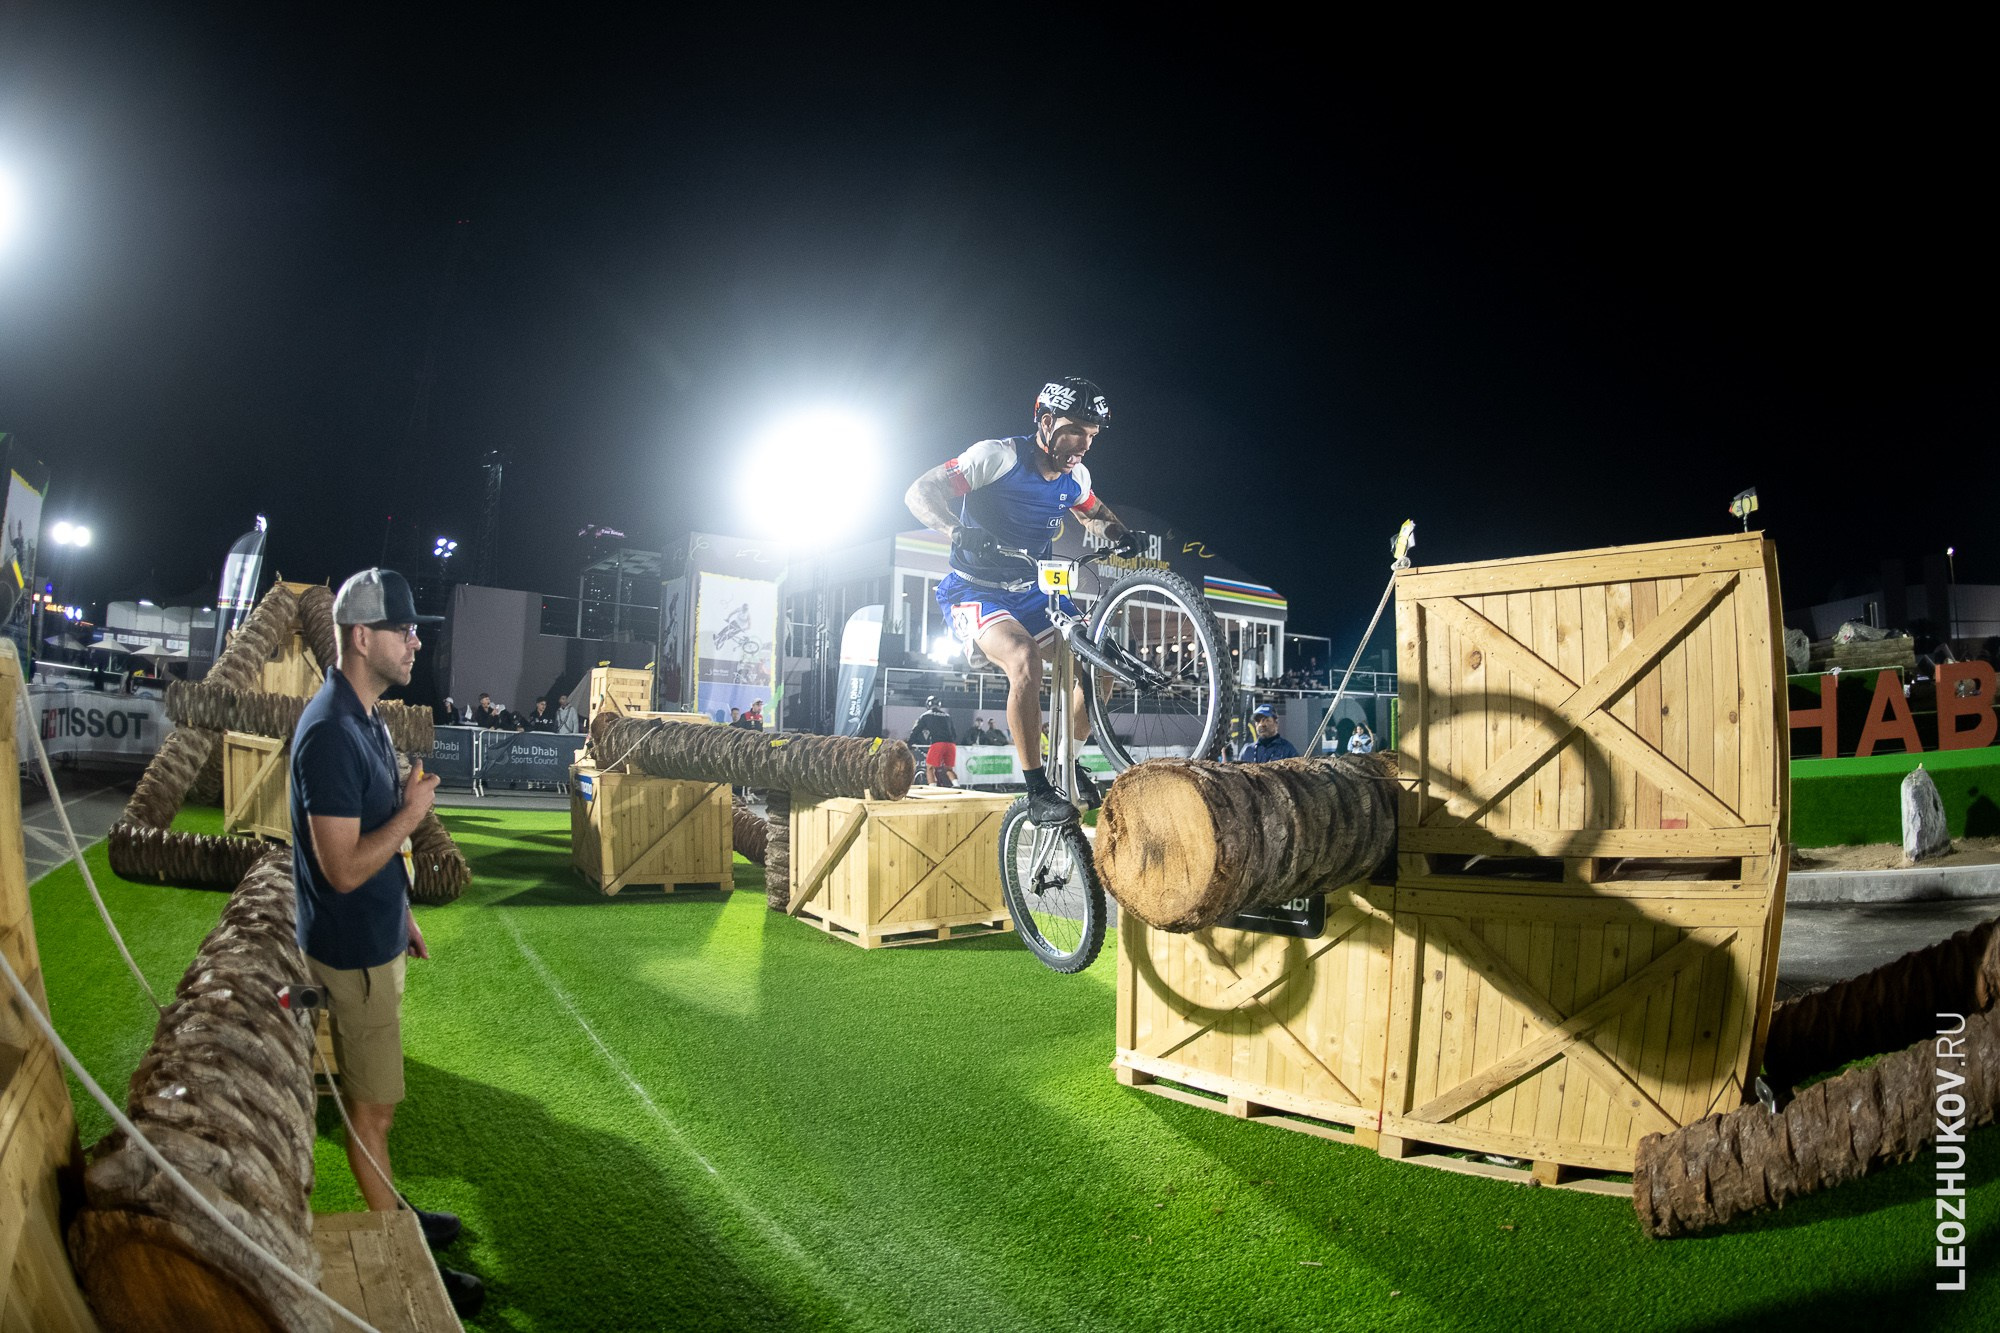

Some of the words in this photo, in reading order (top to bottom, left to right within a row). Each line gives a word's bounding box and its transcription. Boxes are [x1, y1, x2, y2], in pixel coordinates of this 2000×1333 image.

[1042, 383, 1077, 402] TRIAL
[1053, 572, 1061, 584] 5
[850, 677, 859, 700] Dhabi
[849, 700, 857, 717] Abu
[57, 707, 149, 739] TISSOT
[433, 740, 459, 751] Dhabi
[511, 745, 530, 755] Abu
[532, 745, 558, 756] Dhabi
[435, 751, 460, 761] Council
[511, 755, 533, 765] Sports
[534, 756, 559, 765] Council
